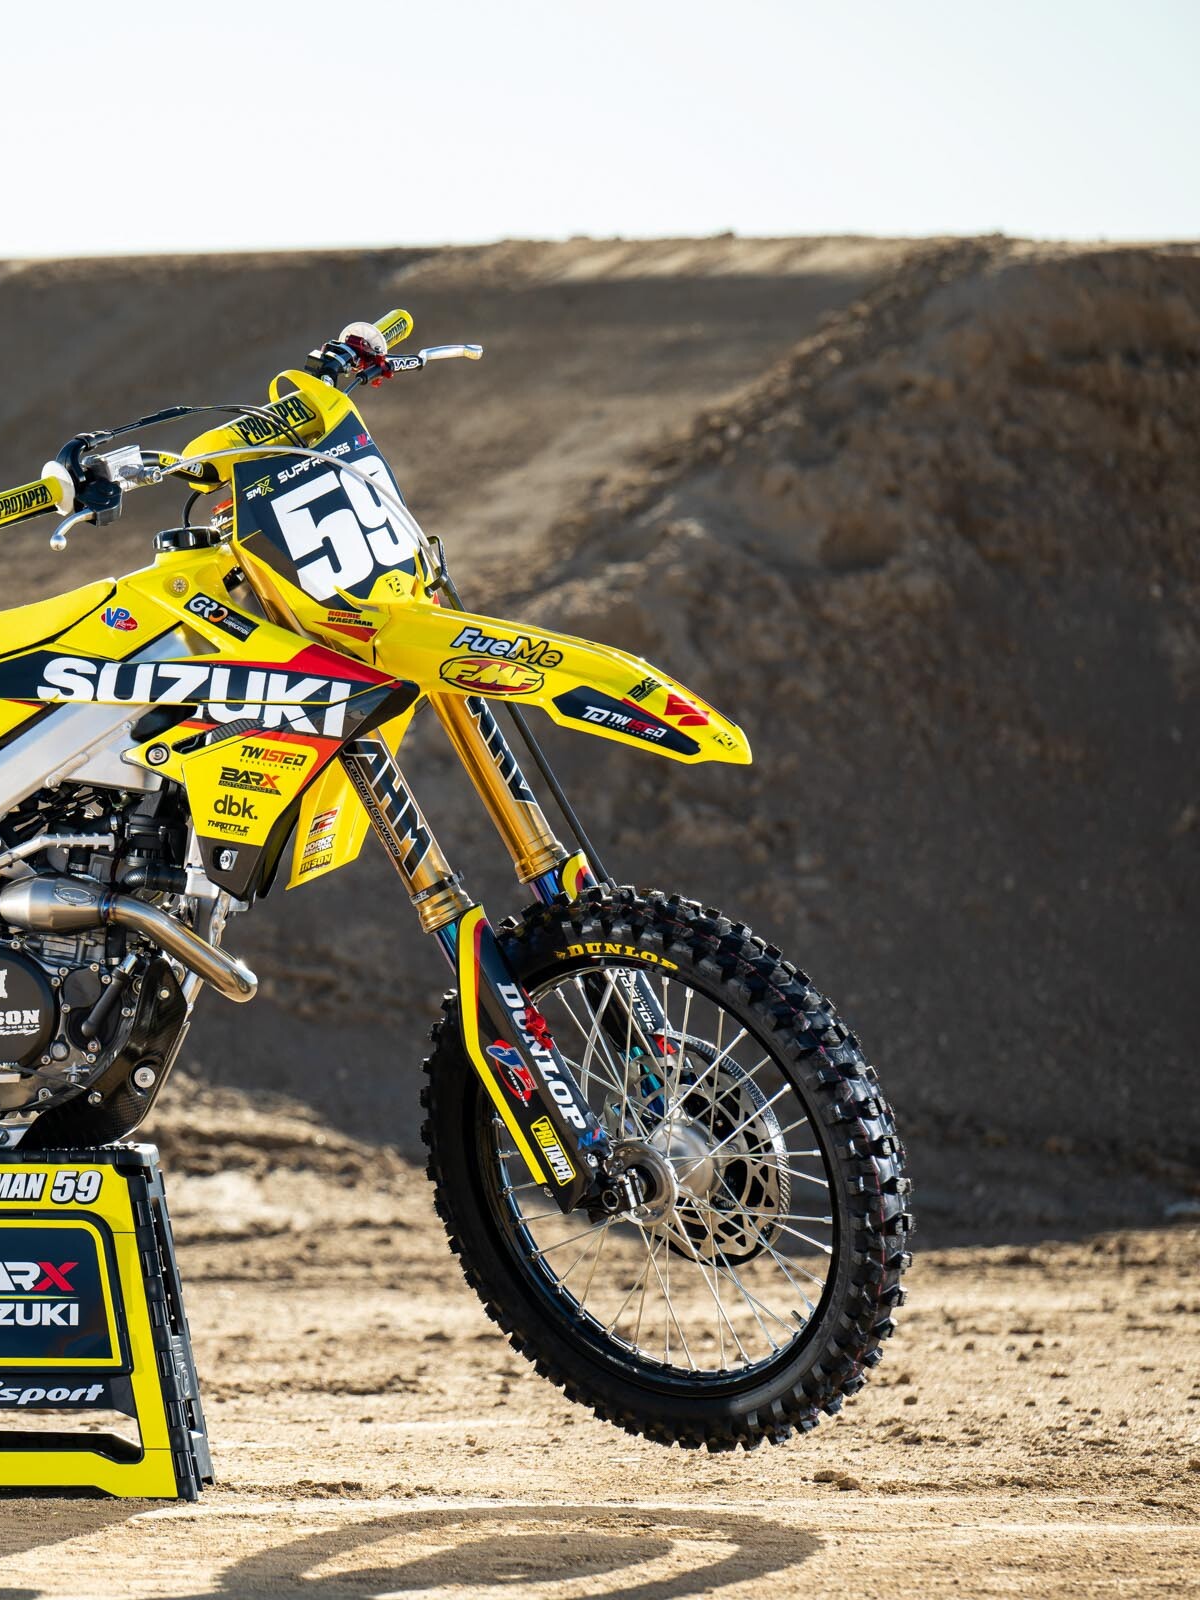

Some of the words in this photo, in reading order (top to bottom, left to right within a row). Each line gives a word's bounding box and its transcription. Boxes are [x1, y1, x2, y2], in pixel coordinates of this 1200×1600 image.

[270, 455, 419, 601] 59
[105, 607, 131, 629] VP
[189, 596, 229, 623] GRO
[327, 616, 373, 627] WAGEMAN
[440, 661, 545, 690] FMF
[37, 657, 351, 738] SUZUKI
[240, 744, 308, 766] TWISTED
[220, 766, 281, 789] BARX
[213, 794, 259, 820] dbk.
[342, 738, 433, 881] AHM
[567, 942, 679, 970] DUNLOP
[496, 982, 587, 1130] DUNLOP
[507, 1069, 529, 1108] PISTONS
[536, 1121, 573, 1182] PROTAPER
[50, 1170, 103, 1204] 59
